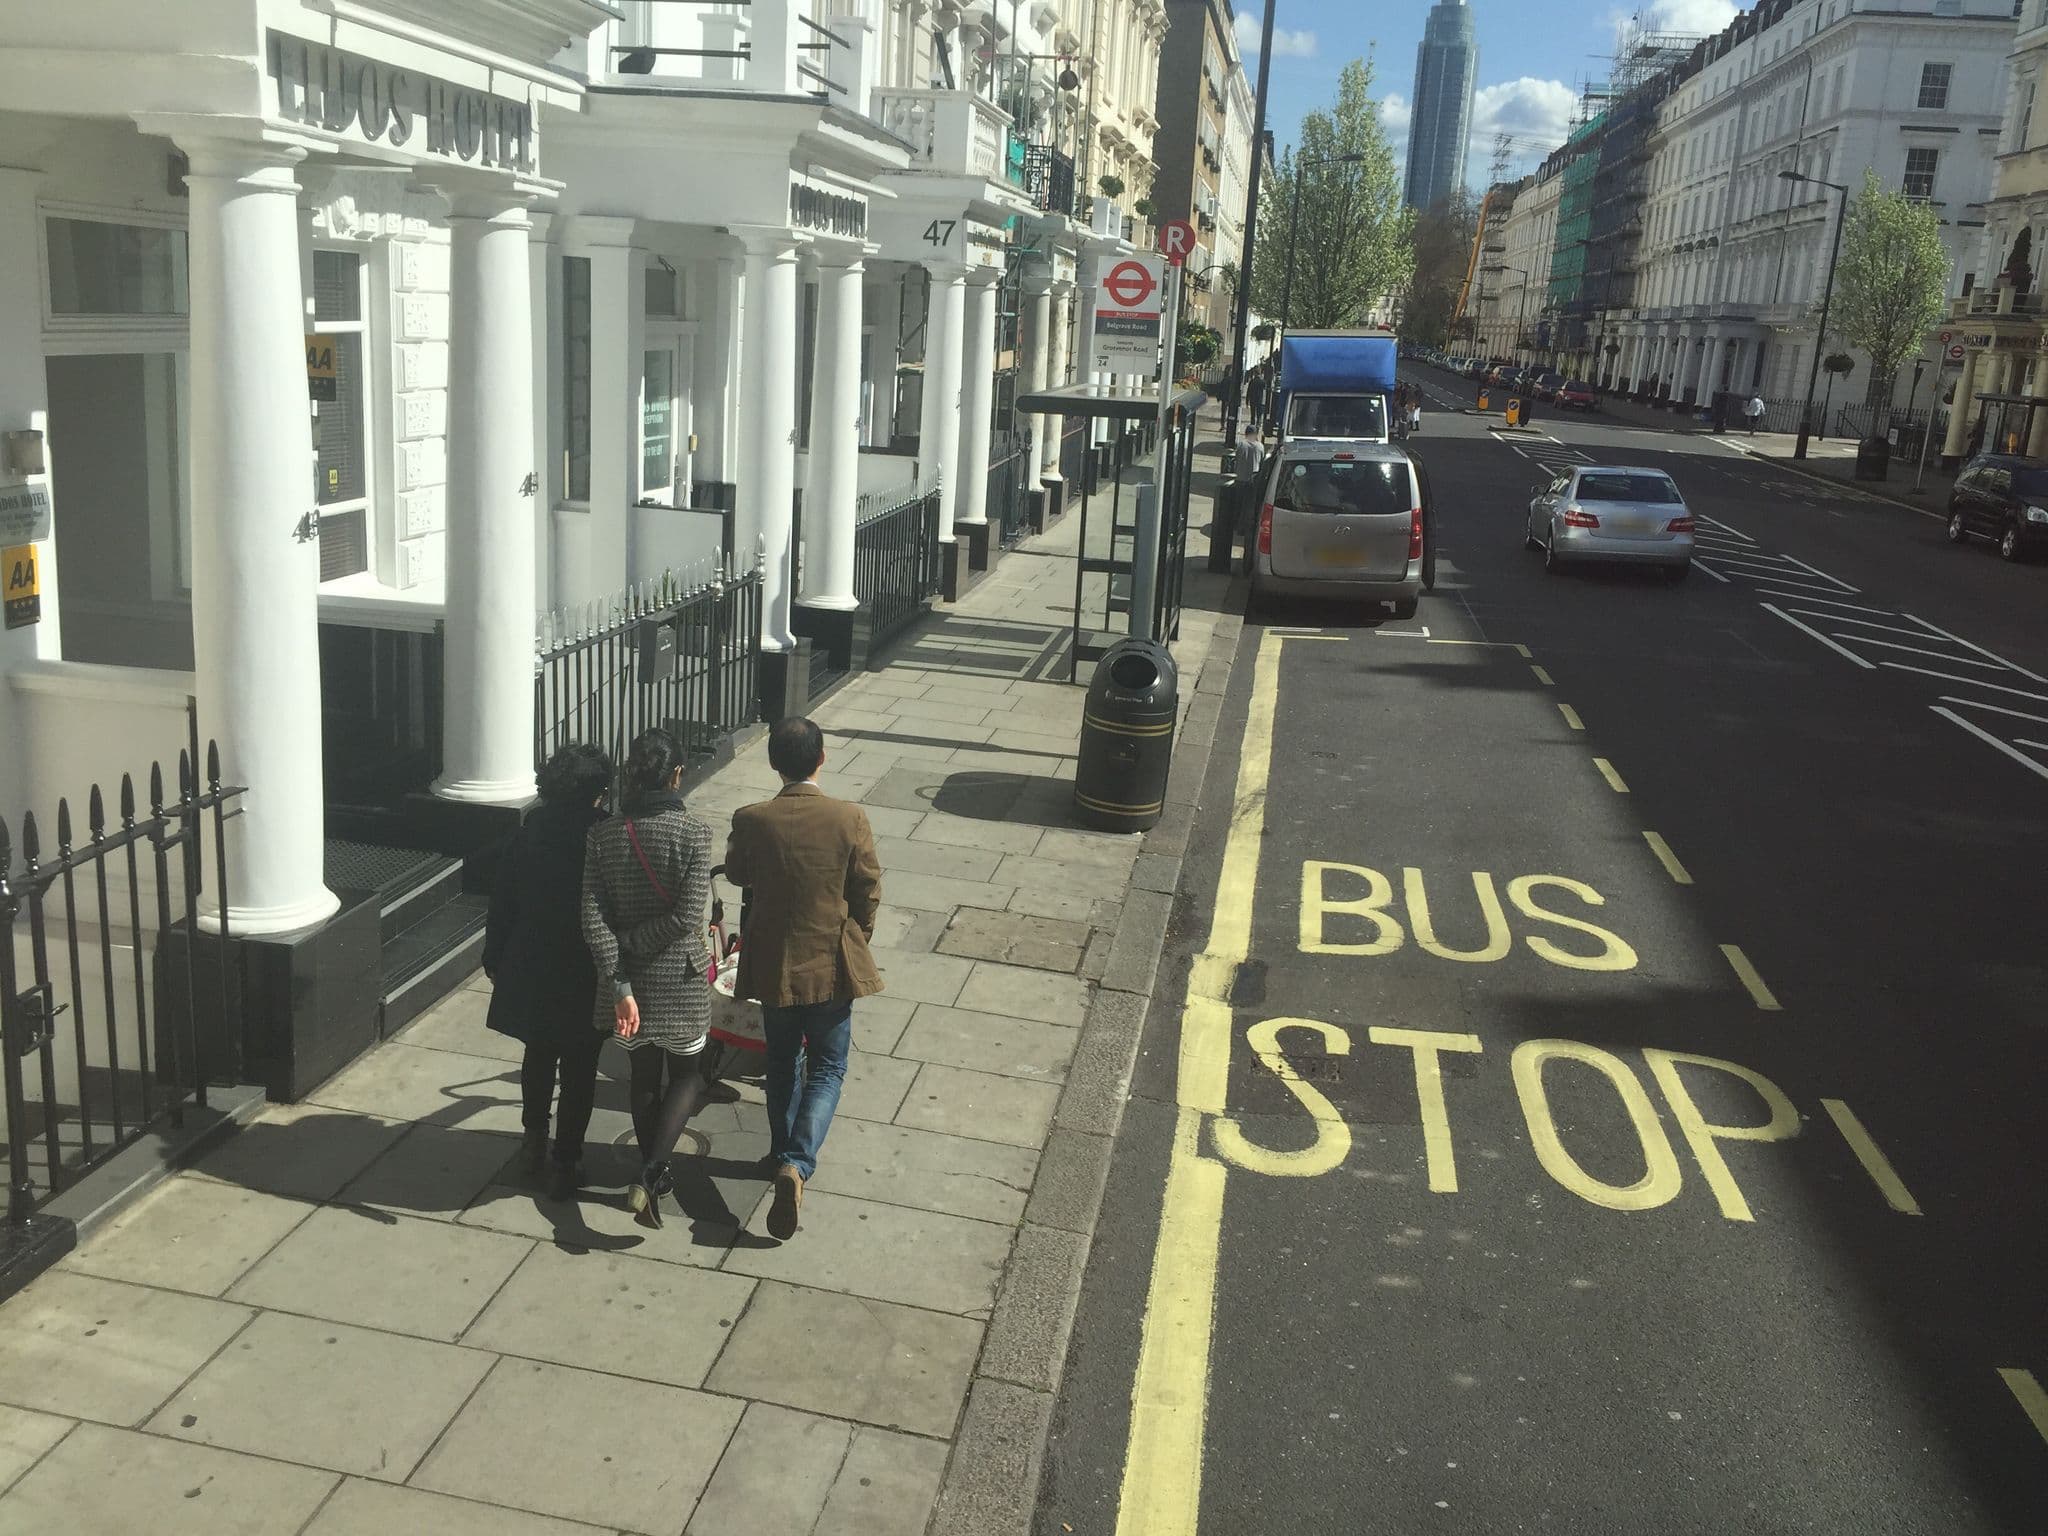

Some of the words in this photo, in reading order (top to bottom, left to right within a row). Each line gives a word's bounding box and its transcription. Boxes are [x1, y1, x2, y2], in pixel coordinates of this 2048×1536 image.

[426, 79, 536, 174] HOTEL
[923, 220, 956, 247] 47
[1166, 225, 1186, 254] R
[1106, 322, 1131, 330] Belgrave
[1132, 323, 1148, 331] Road
[307, 347, 331, 370] AA
[1102, 344, 1132, 352] Grosvenor
[20, 492, 47, 508] HOTEL
[9, 558, 35, 590] AA
[1297, 860, 1638, 971] BUS
[1213, 1016, 1801, 1222] STOP
